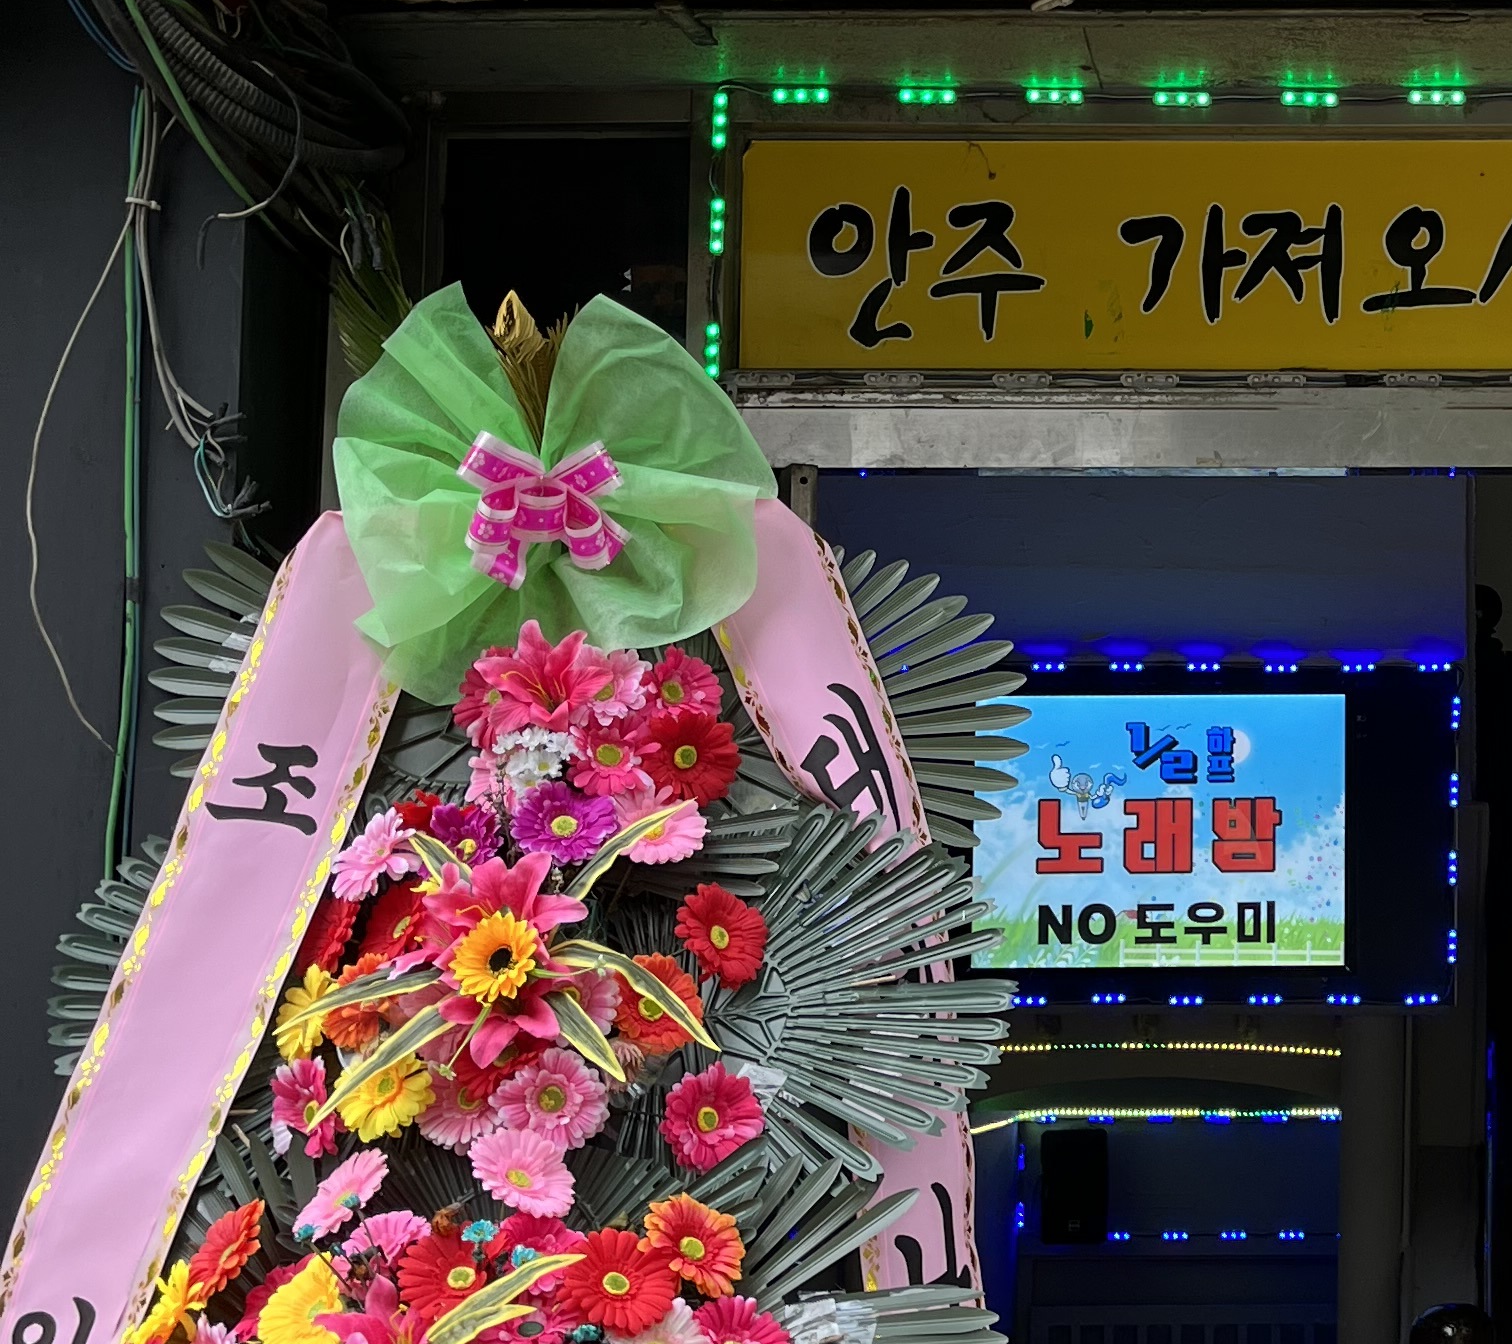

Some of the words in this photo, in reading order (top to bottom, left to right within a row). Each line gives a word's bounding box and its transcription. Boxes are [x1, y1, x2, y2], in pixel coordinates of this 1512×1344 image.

[808, 186, 1046, 348] 안주
[1036, 796, 1283, 875] 노래밤
[1037, 903, 1117, 946] NO
[1134, 900, 1276, 946] 도우미
